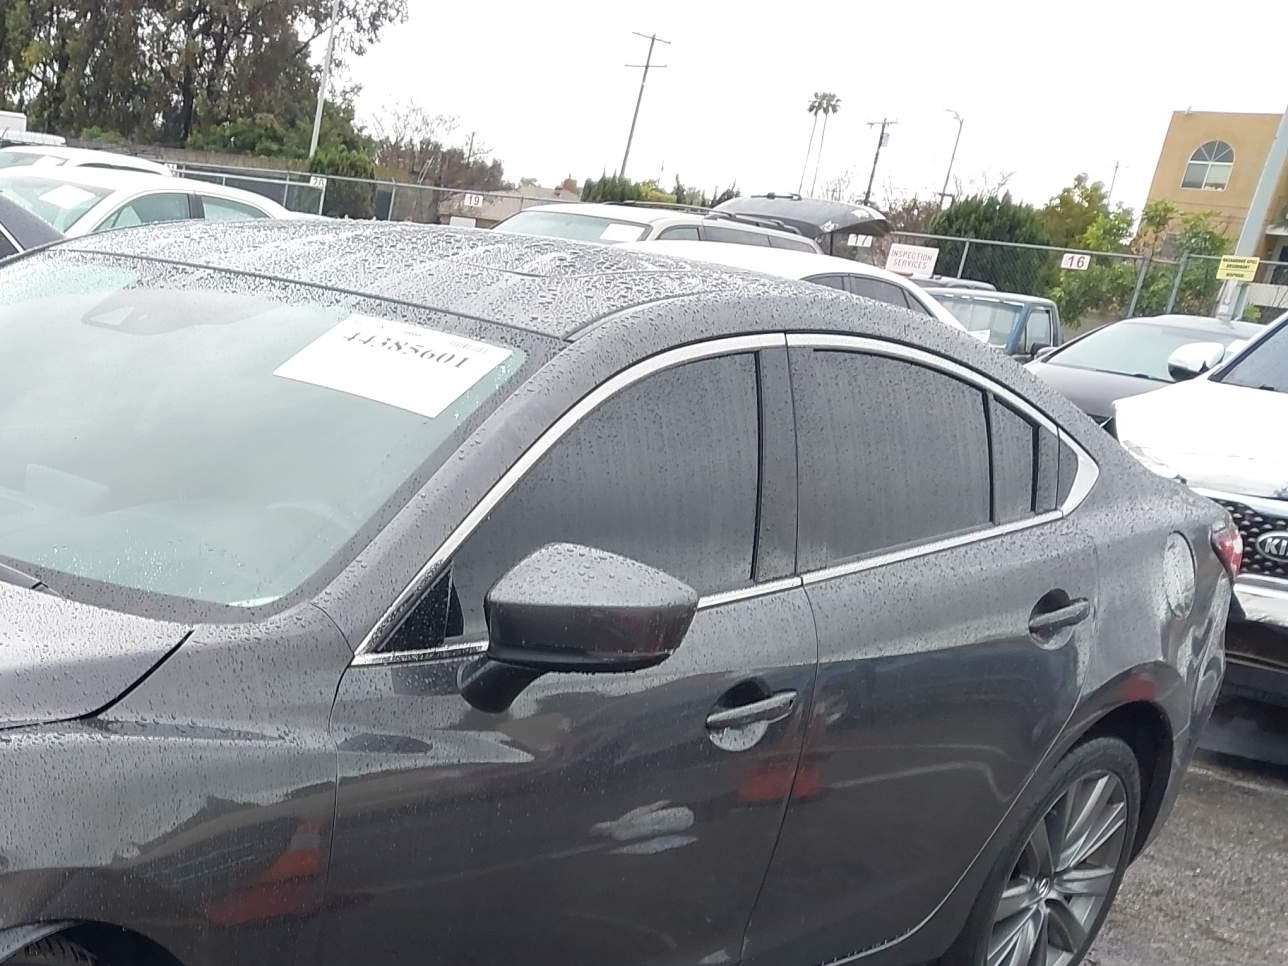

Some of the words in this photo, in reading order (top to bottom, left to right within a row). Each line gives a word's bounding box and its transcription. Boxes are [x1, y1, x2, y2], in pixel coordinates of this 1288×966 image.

[468, 195, 480, 206] 19
[891, 249, 932, 261] INSPECTION
[893, 258, 928, 269] SERVICES
[1068, 255, 1085, 268] 16
[344, 331, 469, 368] 44385601
[1264, 537, 1288, 557] KI
